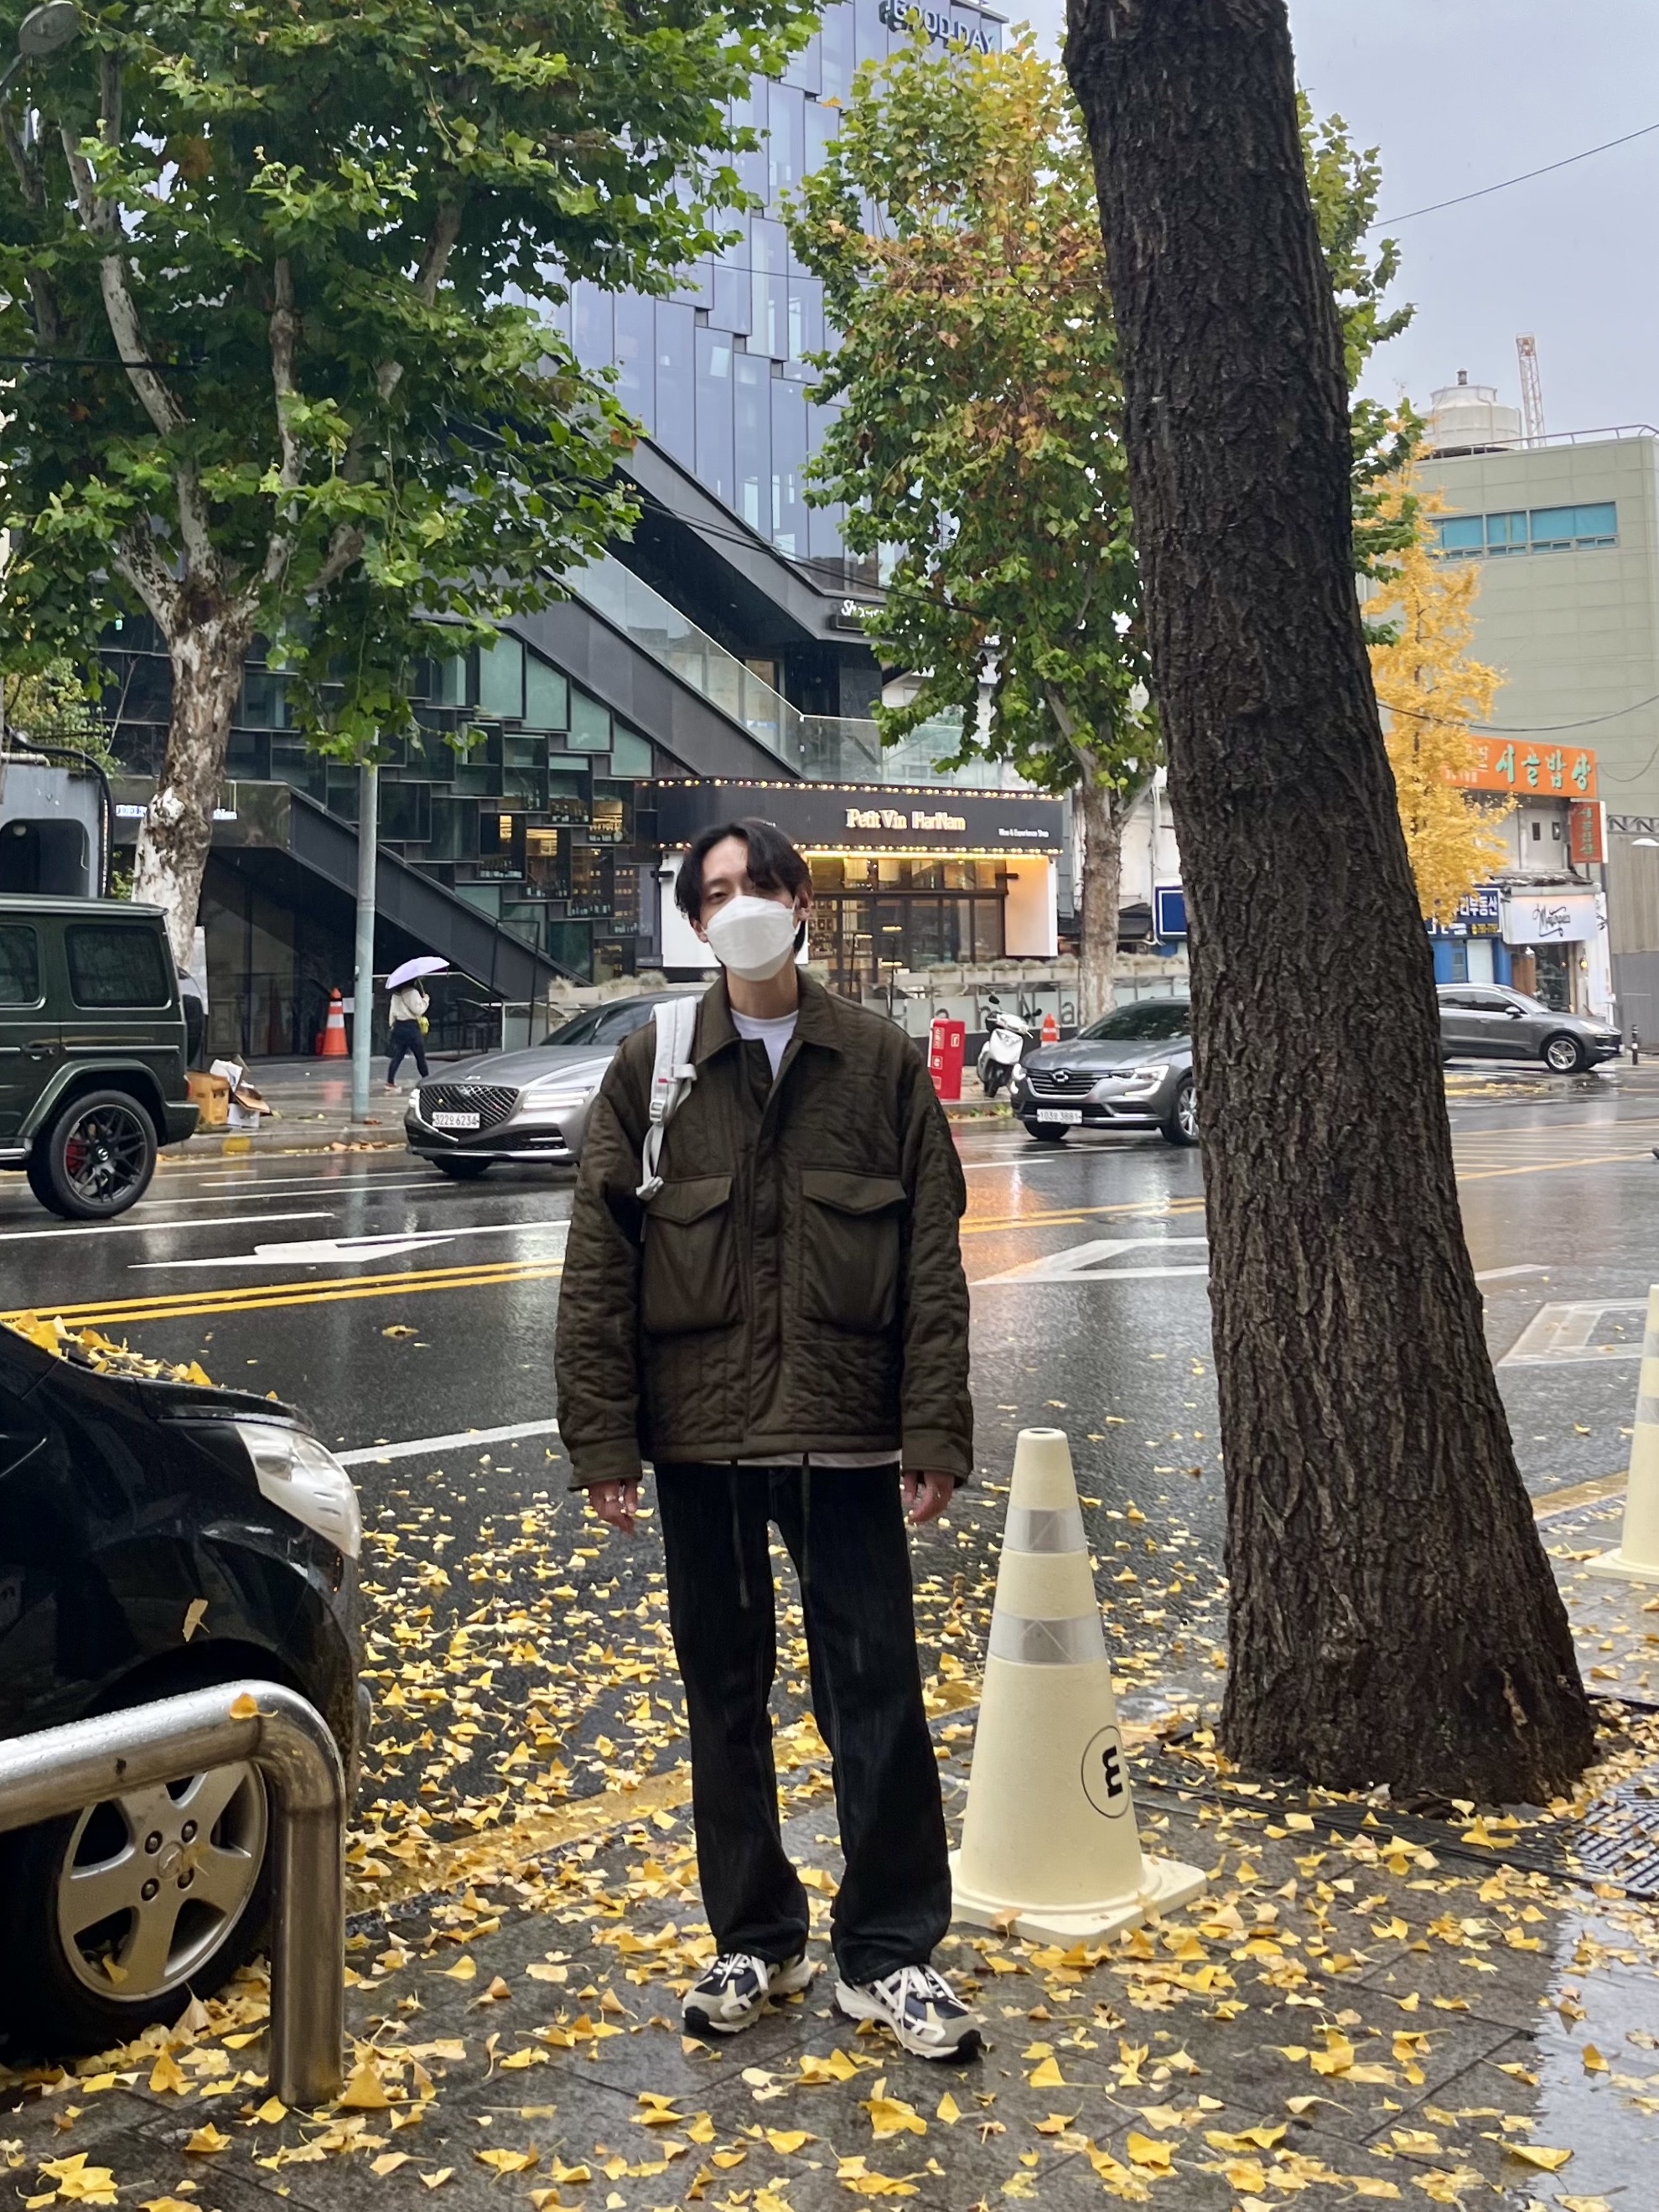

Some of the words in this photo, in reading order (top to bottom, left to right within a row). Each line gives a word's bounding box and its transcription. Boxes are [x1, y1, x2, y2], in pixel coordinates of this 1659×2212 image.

[957, 21, 993, 54] DAY
[846, 808, 881, 829] Petit
[879, 809, 907, 830] Vin
[911, 811, 966, 831] HanNam
[435, 1114, 454, 1126] 322오
[455, 1115, 477, 1127] 6234
